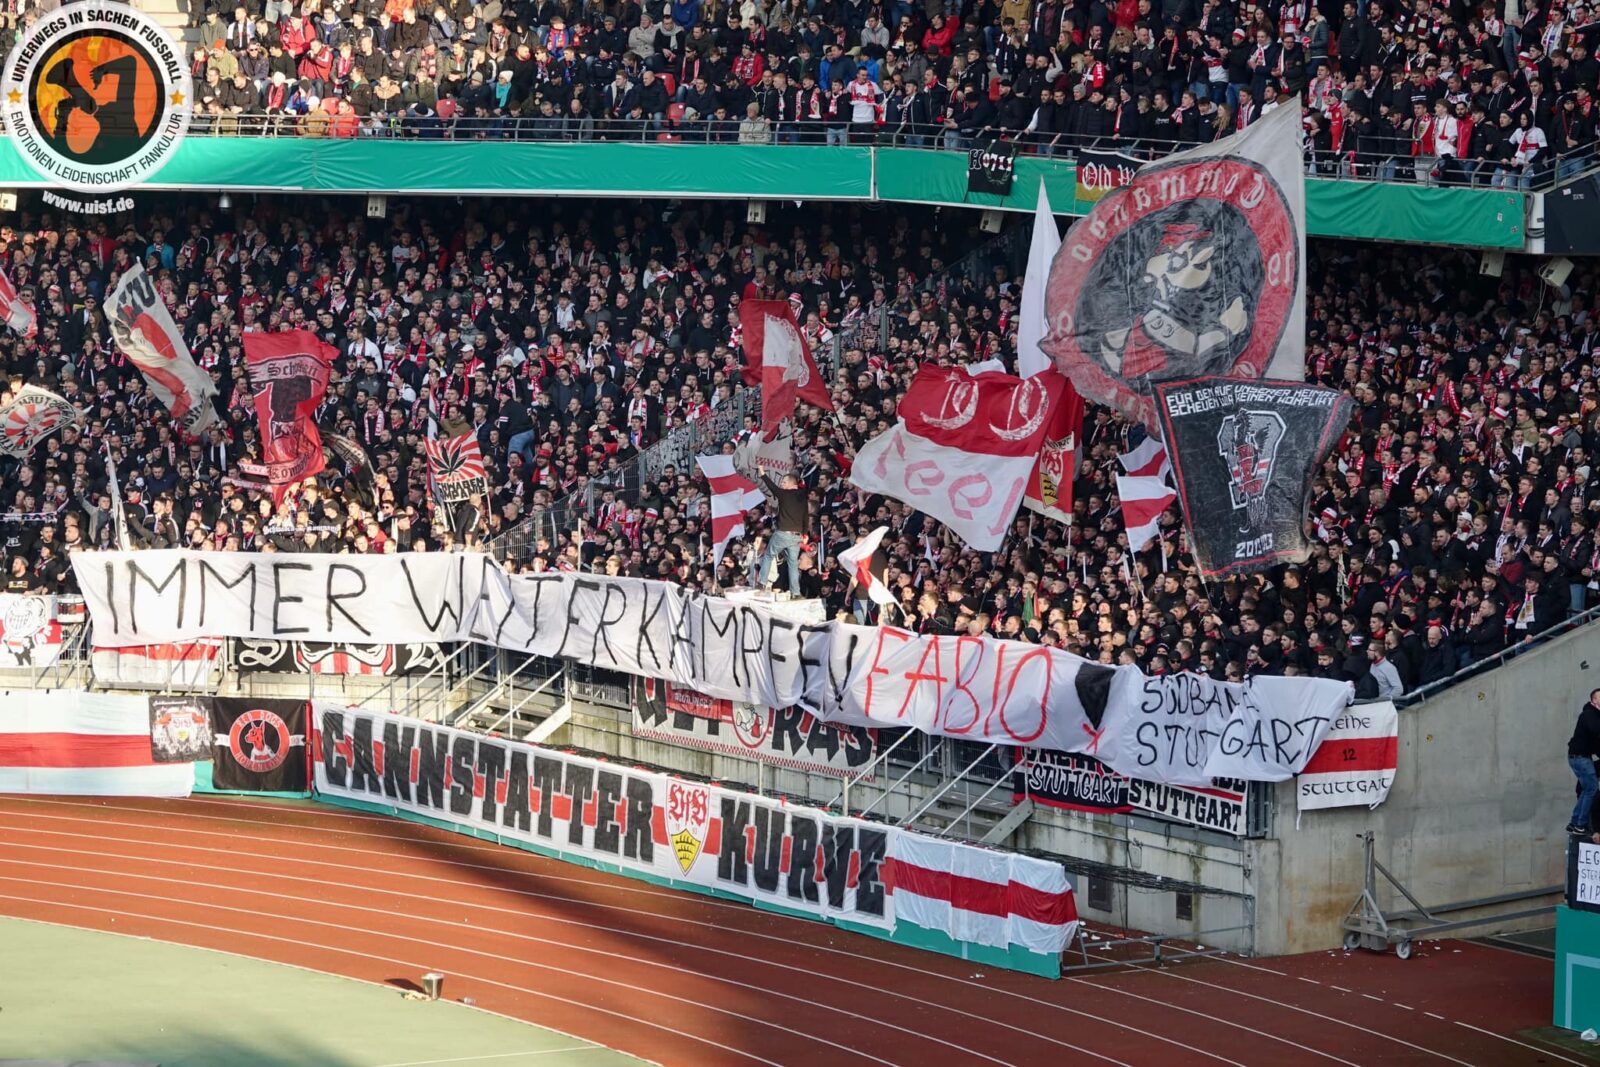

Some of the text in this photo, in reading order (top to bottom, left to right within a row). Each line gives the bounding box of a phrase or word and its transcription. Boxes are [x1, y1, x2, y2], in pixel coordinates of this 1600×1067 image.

[1082, 161, 1112, 191] Old
[1166, 392, 1193, 406] FÜR
[1169, 398, 1219, 417] SCHEUEN
[105, 556, 371, 638] IMMER
[864, 626, 1053, 742] FABIO
[1342, 747, 1357, 761] 12
[322, 710, 654, 863] CANNSTATTER
[1028, 763, 1123, 804] STUTTGART
[1129, 777, 1242, 832] STUTTGART
[717, 796, 888, 917] KURVE
